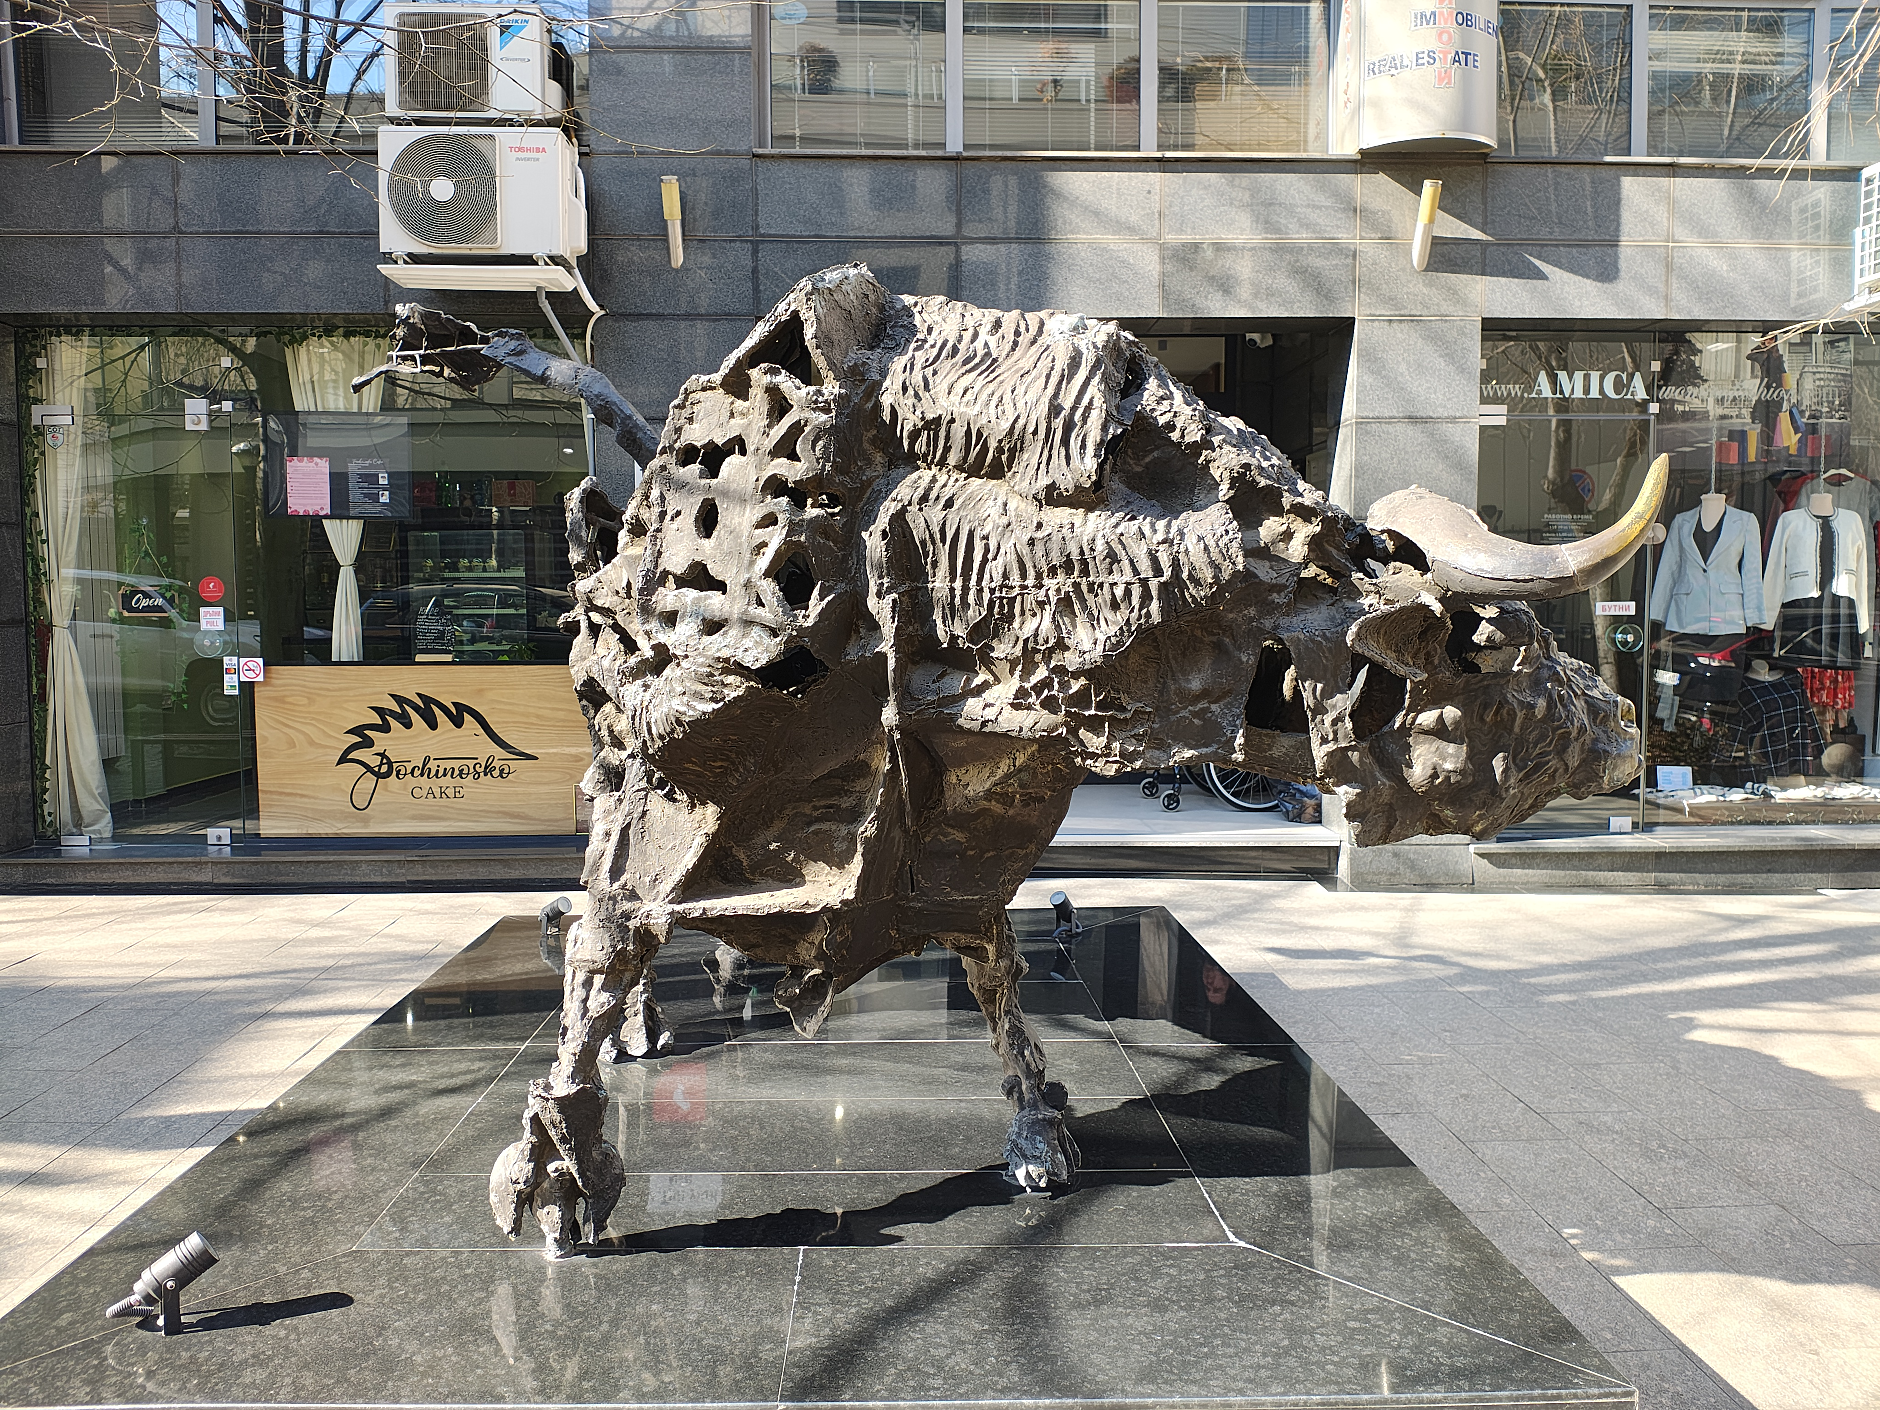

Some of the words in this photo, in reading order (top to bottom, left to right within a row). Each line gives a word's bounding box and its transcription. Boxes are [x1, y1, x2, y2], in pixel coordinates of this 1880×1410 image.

[1413, 10, 1498, 40] IMMOBILIEN
[1366, 53, 1409, 78] REAL
[1415, 49, 1480, 70] ESTATE
[131, 593, 164, 609] Open
[1601, 604, 1631, 612] БУТНИ
[410, 785, 465, 799] CAKE
